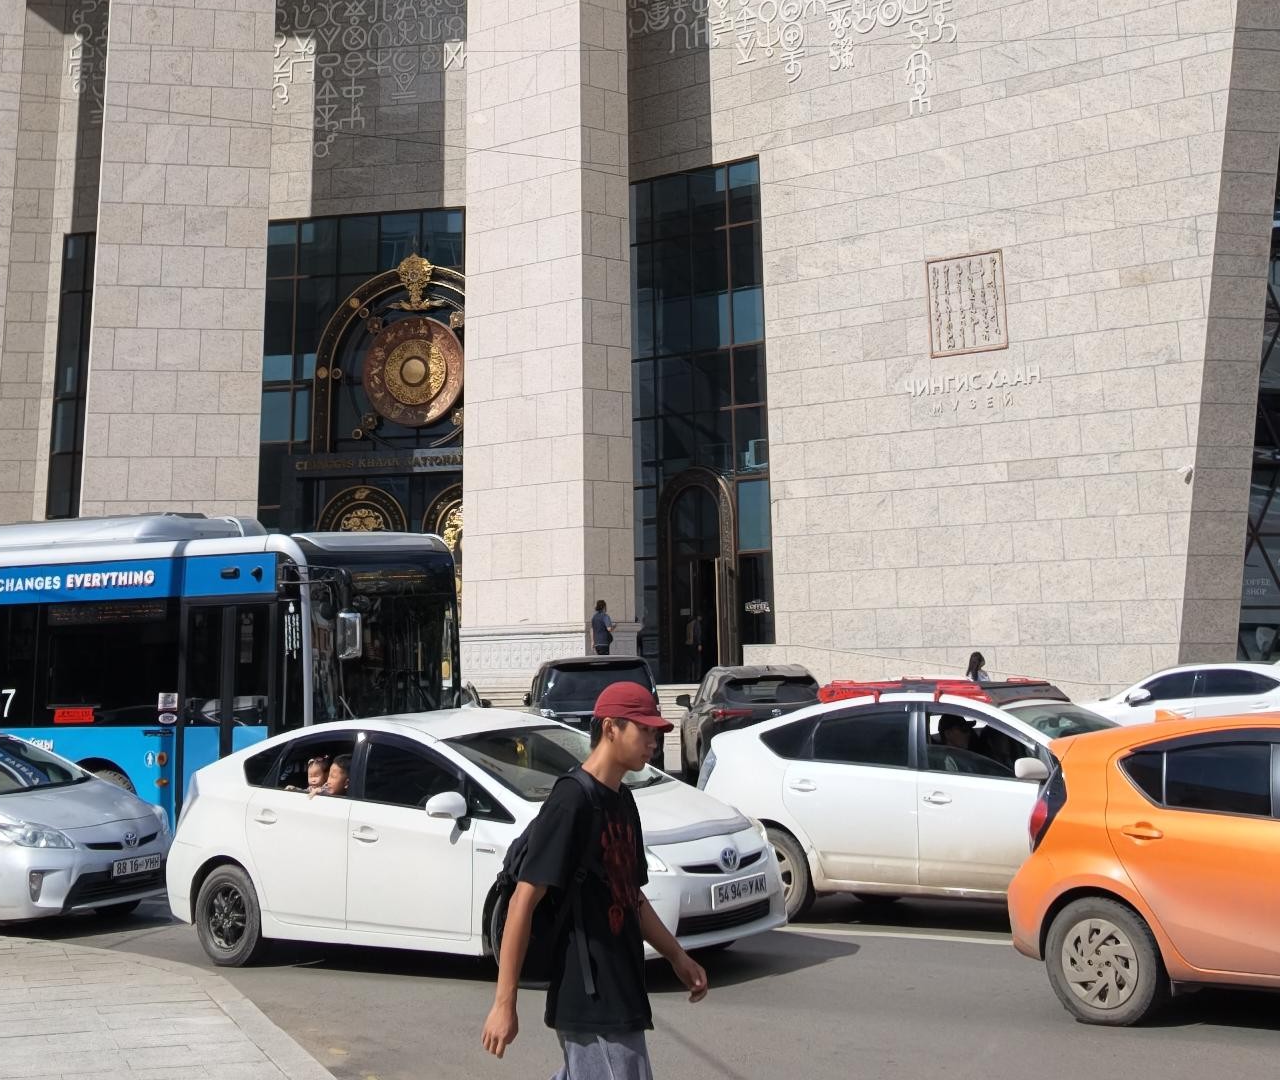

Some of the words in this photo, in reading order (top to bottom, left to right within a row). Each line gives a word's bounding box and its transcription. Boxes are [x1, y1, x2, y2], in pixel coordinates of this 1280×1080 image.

[904, 372, 982, 397] ЧИНГИС
[986, 363, 1042, 390] ХААН
[930, 392, 1014, 414] МУЗЕЙ
[66, 570, 156, 589] EVERYTHING
